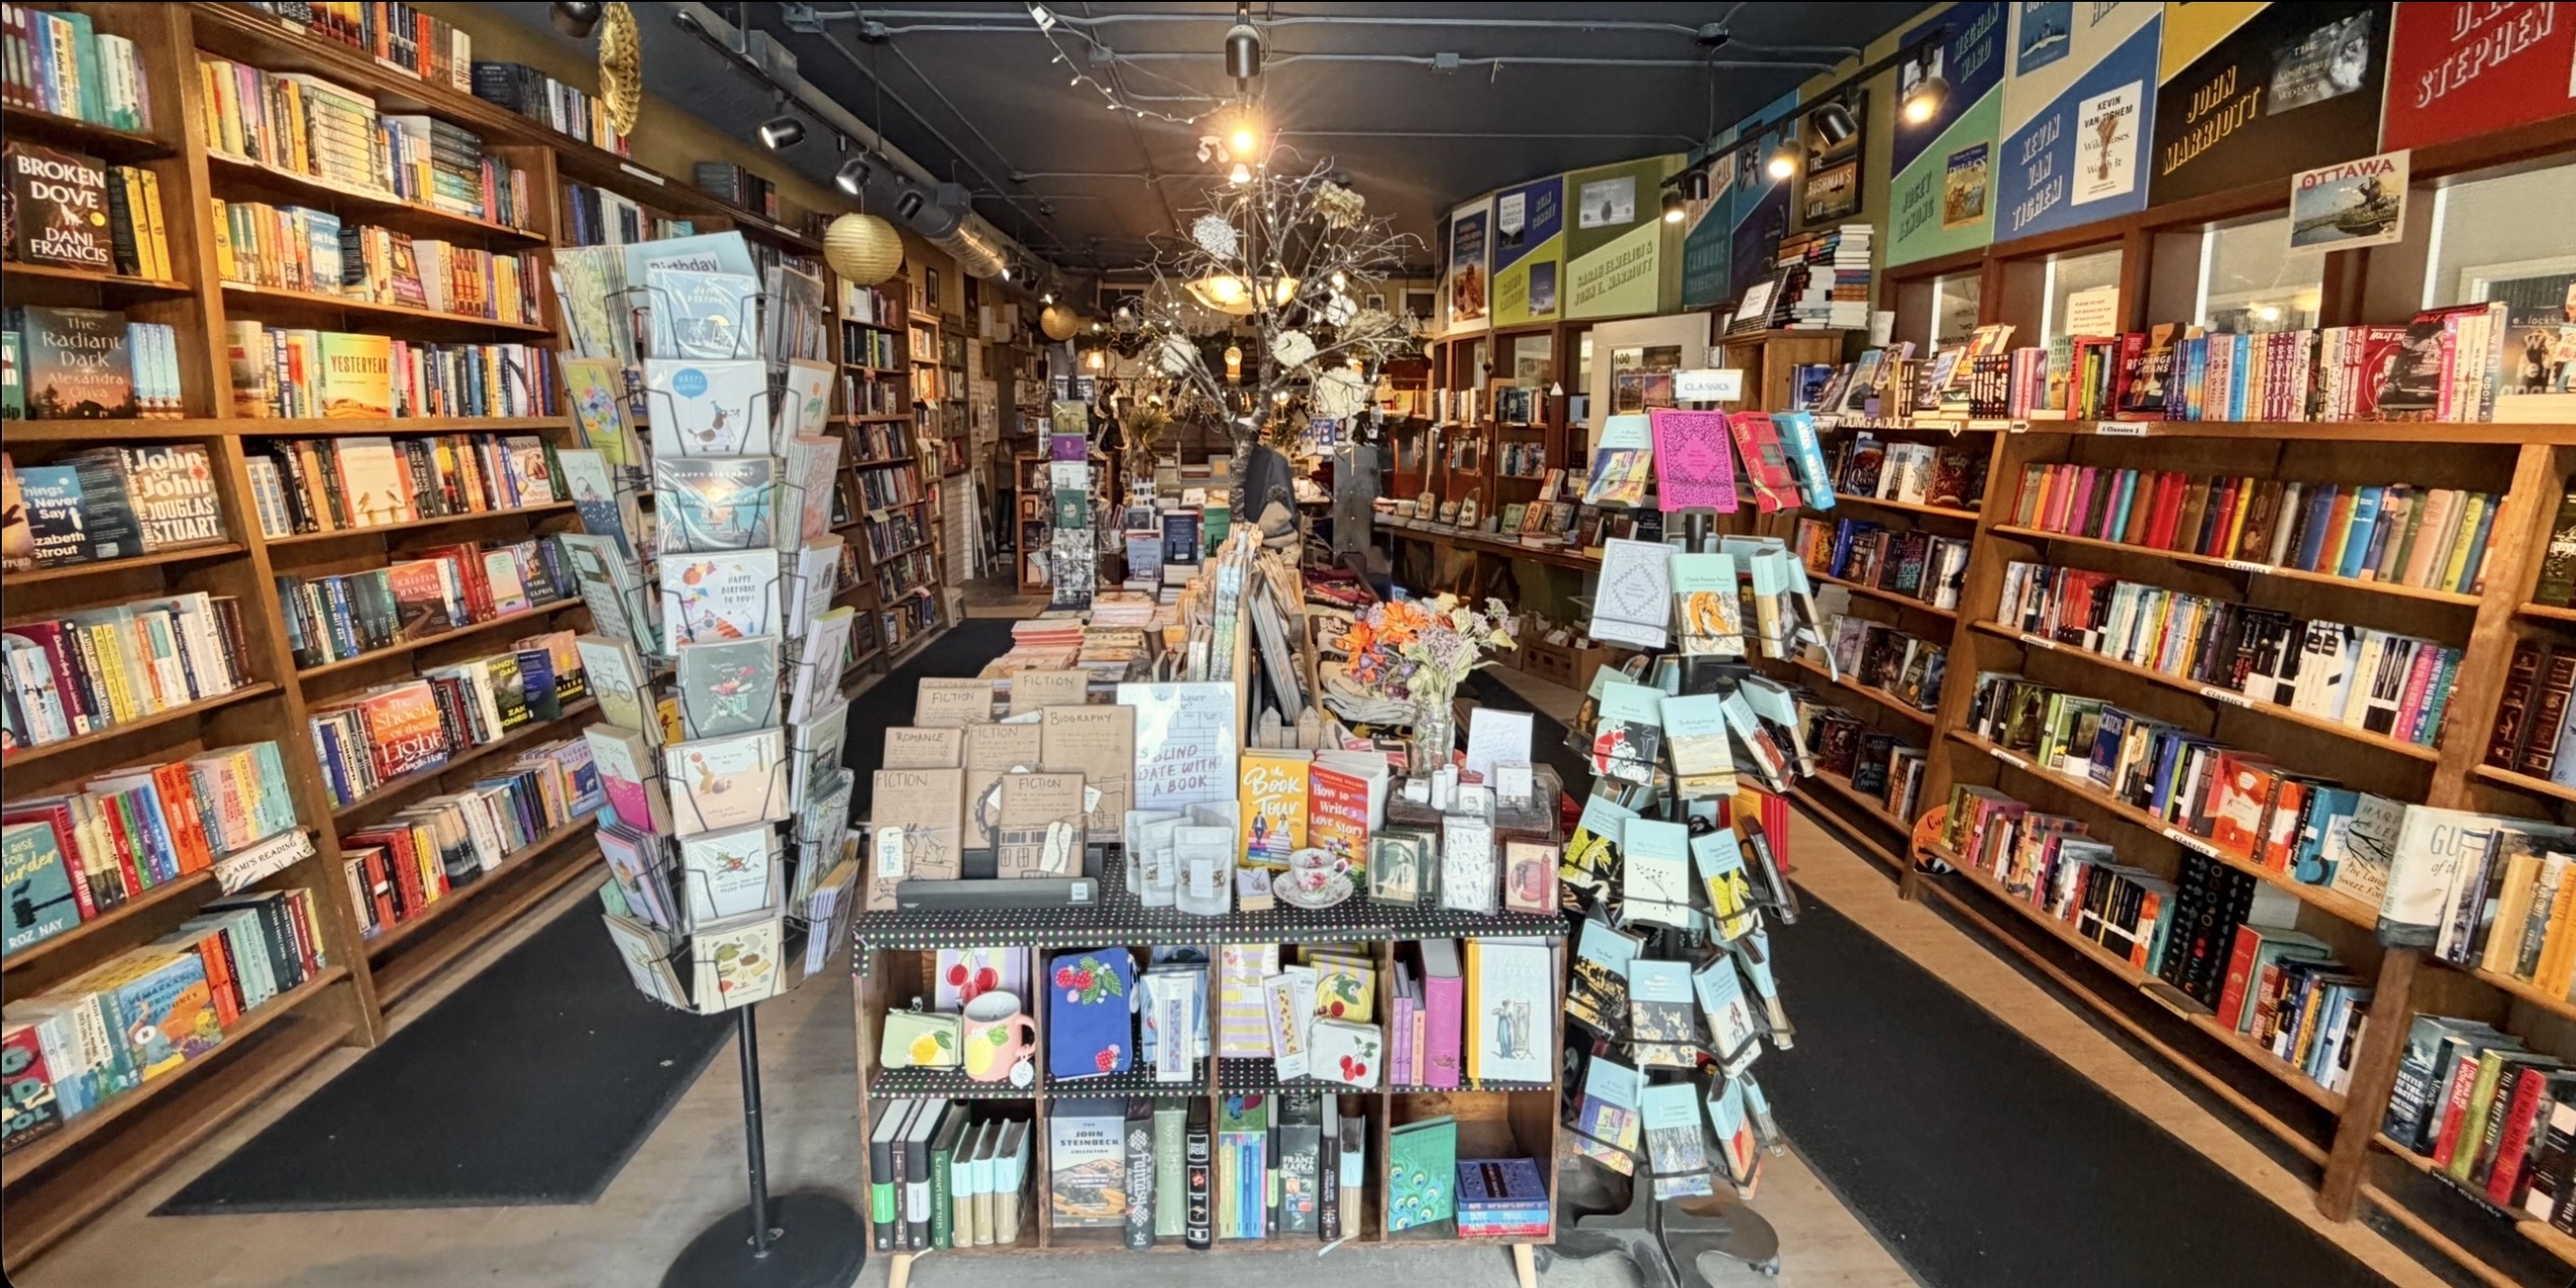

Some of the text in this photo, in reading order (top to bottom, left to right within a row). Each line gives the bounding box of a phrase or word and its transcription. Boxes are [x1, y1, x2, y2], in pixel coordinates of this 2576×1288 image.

[2415, 2, 2556, 108] STEPHEN
[2186, 65, 2236, 123] JOHN
[2097, 96, 2122, 111] KEVIN
[2084, 117, 2099, 128] VAN
[2163, 86, 2260, 175] MARRIOTT
[17, 155, 104, 188] BROKEN
[2301, 158, 2395, 190] OTTAWA
[31, 181, 99, 210] DOVE
[45, 227, 94, 247] DANI
[31, 239, 108, 262] FRANCIS
[68, 318, 96, 329] The
[42, 331, 122, 351] Radiant
[61, 352, 110, 368] Dark
[331, 355, 388, 375] YESTERYEAR
[1614, 353, 1631, 365] 100
[49, 373, 124, 385] Alexandra
[1683, 383, 1730, 391] CLASSICS
[1873, 416, 1911, 430] ADULT
[134, 448, 201, 473] John
[20, 483, 64, 498] hings
[143, 473, 211, 498] John
[35, 496, 79, 509] Never
[148, 497, 216, 521] DOUGLAS
[40, 509, 67, 521] Say
[152, 516, 220, 543] STUART
[34, 531, 86, 546] zabeth
[35, 544, 78, 559] Strout
[398, 573, 435, 587] KRISTIN
[728, 575, 751, 584] HAPPY
[400, 583, 439, 597] HANNAH
[529, 586, 554, 597] ELPRIN
[721, 585, 755, 594] BIRTHDAY
[499, 667, 516, 677] GAP
[1023, 675, 1075, 687] FICTION
[932, 692, 974, 703] FICTION
[2205, 689, 2244, 706] Classics
[375, 703, 432, 729] Shock
[508, 705, 526, 717] ZAK
[1051, 712, 1112, 726] BIOGRAPHY
[896, 732, 944, 743] ROMANCE
[970, 726, 1019, 738] FICTION
[381, 730, 444, 763] Light
[1153, 745, 1198, 762] BLIND
[1138, 757, 1218, 781] DATE WITH
[876, 773, 928, 787] FICTION
[1019, 778, 1062, 790] FICTION
[1152, 775, 1208, 797] A BOOK
[1313, 784, 1350, 801] How to
[1320, 801, 1349, 816] Write
[1310, 812, 1364, 837] Love Story
[259, 840, 297, 862] READING
[2173, 834, 2210, 856] Classics
[2, 848, 55, 888] urder
[8, 918, 63, 950] ROZ NAY
[1283, 1156, 1315, 1165] FRANZ
[1283, 1163, 1315, 1171] KAFKA
